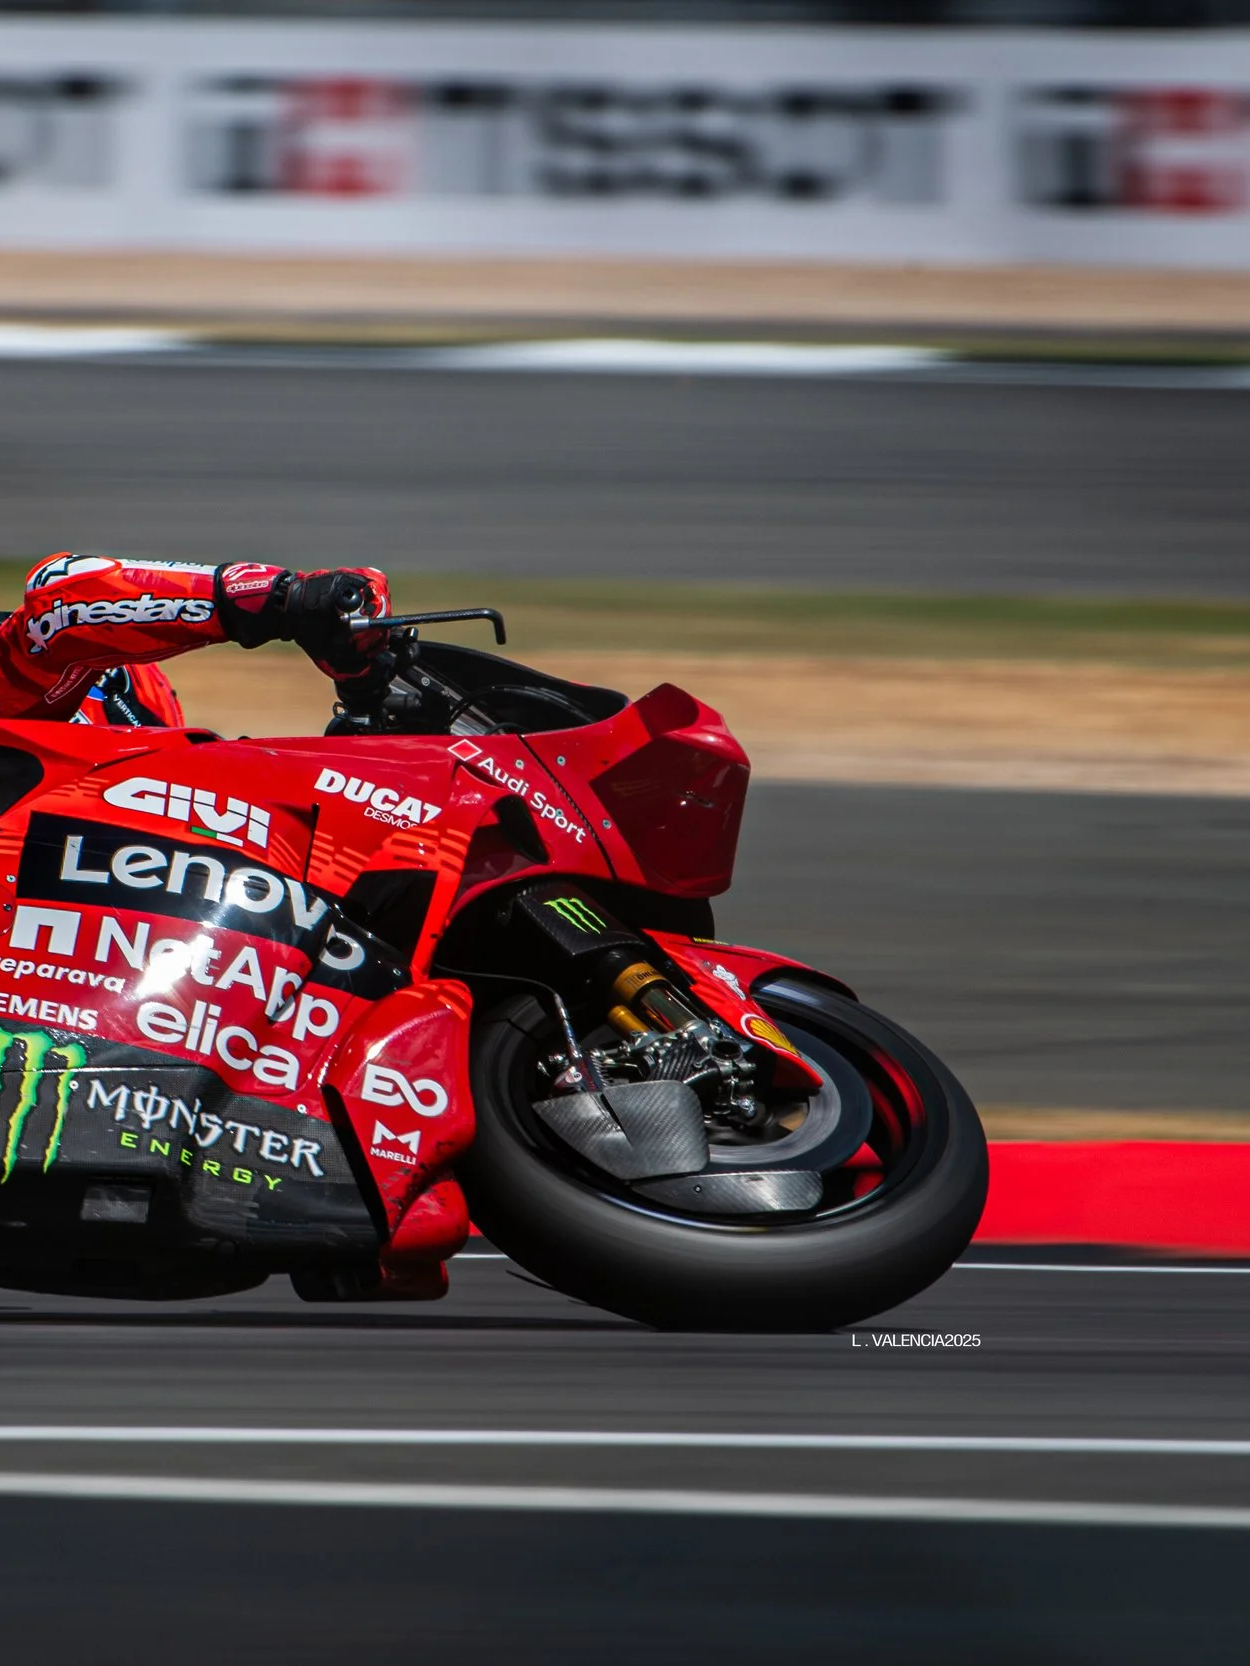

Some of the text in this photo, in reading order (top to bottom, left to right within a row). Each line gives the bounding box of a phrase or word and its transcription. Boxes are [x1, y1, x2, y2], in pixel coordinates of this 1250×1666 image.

[103, 777, 271, 849] GIVI
[478, 757, 586, 844] Audi Sport
[59, 834, 366, 971] Lenovo
[95, 915, 340, 1042] NetApp
[136, 1000, 301, 1091] elica
[120, 1131, 283, 1191] ENERGY
[370, 1146, 417, 1166] MARELLI
